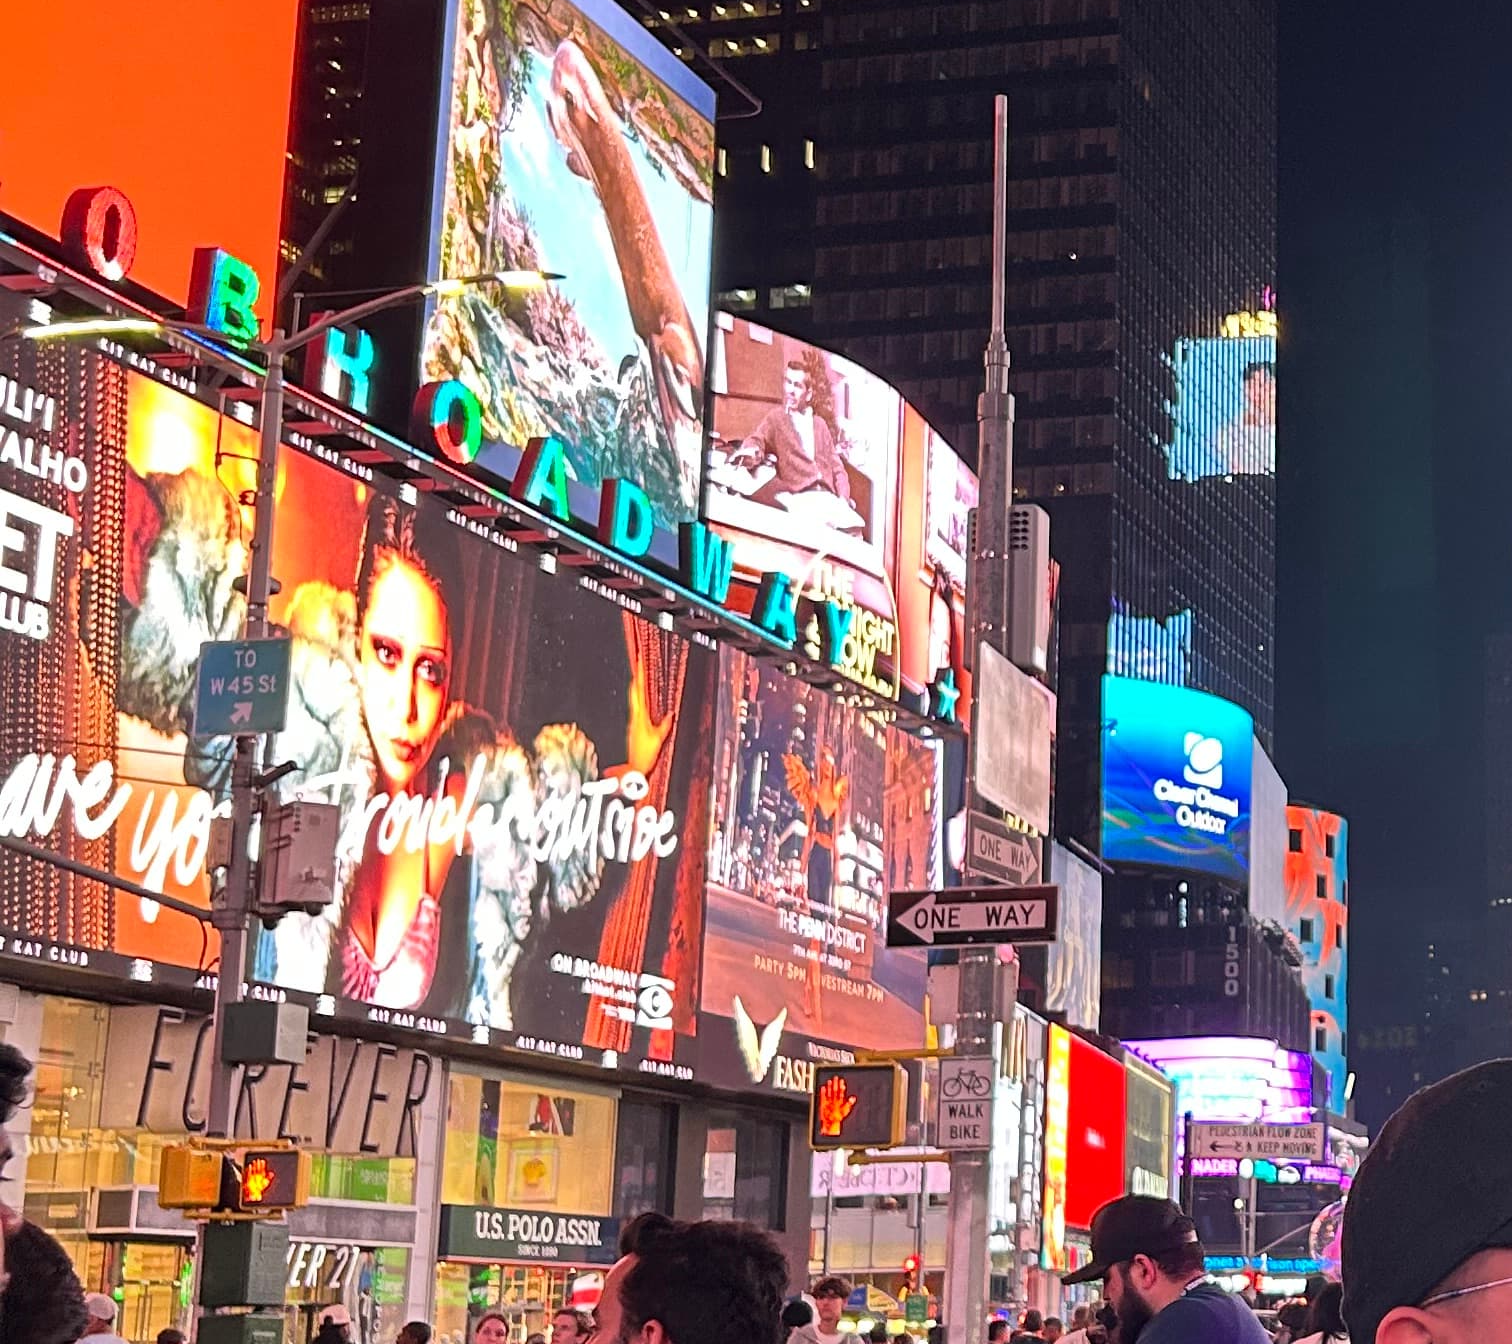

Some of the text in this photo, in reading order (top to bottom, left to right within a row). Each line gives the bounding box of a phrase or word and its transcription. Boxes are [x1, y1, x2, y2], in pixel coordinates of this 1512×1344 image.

[98, 337, 197, 395] KIT KAT CLUB
[200, 248, 854, 666] BROADWAY
[290, 430, 374, 482] KIT KAT CLUB
[448, 509, 468, 527] KIT
[811, 561, 856, 601] THE
[234, 649, 257, 669] TO
[210, 674, 277, 697] W 45 St
[1176, 804, 1227, 835] Outdoor
[979, 833, 1032, 872] ONE WAY
[777, 907, 798, 934] THE
[825, 922, 866, 954] DISTRICT
[913, 903, 1036, 930] ONE WAY
[13, 938, 43, 958] KAT
[50, 945, 89, 967] CLUB
[1224, 925, 1240, 996] 1500
[551, 953, 638, 989] ON BROADWAY
[754, 954, 884, 1002] PARTY 5PM VESTREAM 7PM
[253, 985, 287, 1005] CLUB
[367, 1007, 447, 1035] KIT KAT CLUB
[948, 1104, 984, 1119] WALK
[949, 1124, 981, 1140] BIKE
[1208, 1125, 1318, 1139] PEDESTRIAN FLOW ZONE
[1256, 1143, 1317, 1155] KEEP MOVING
[475, 1210, 602, 1247] U.S. POLO ASSN.
[517, 1243, 541, 1256] SINCE
[328, 1244, 361, 1289] 21
